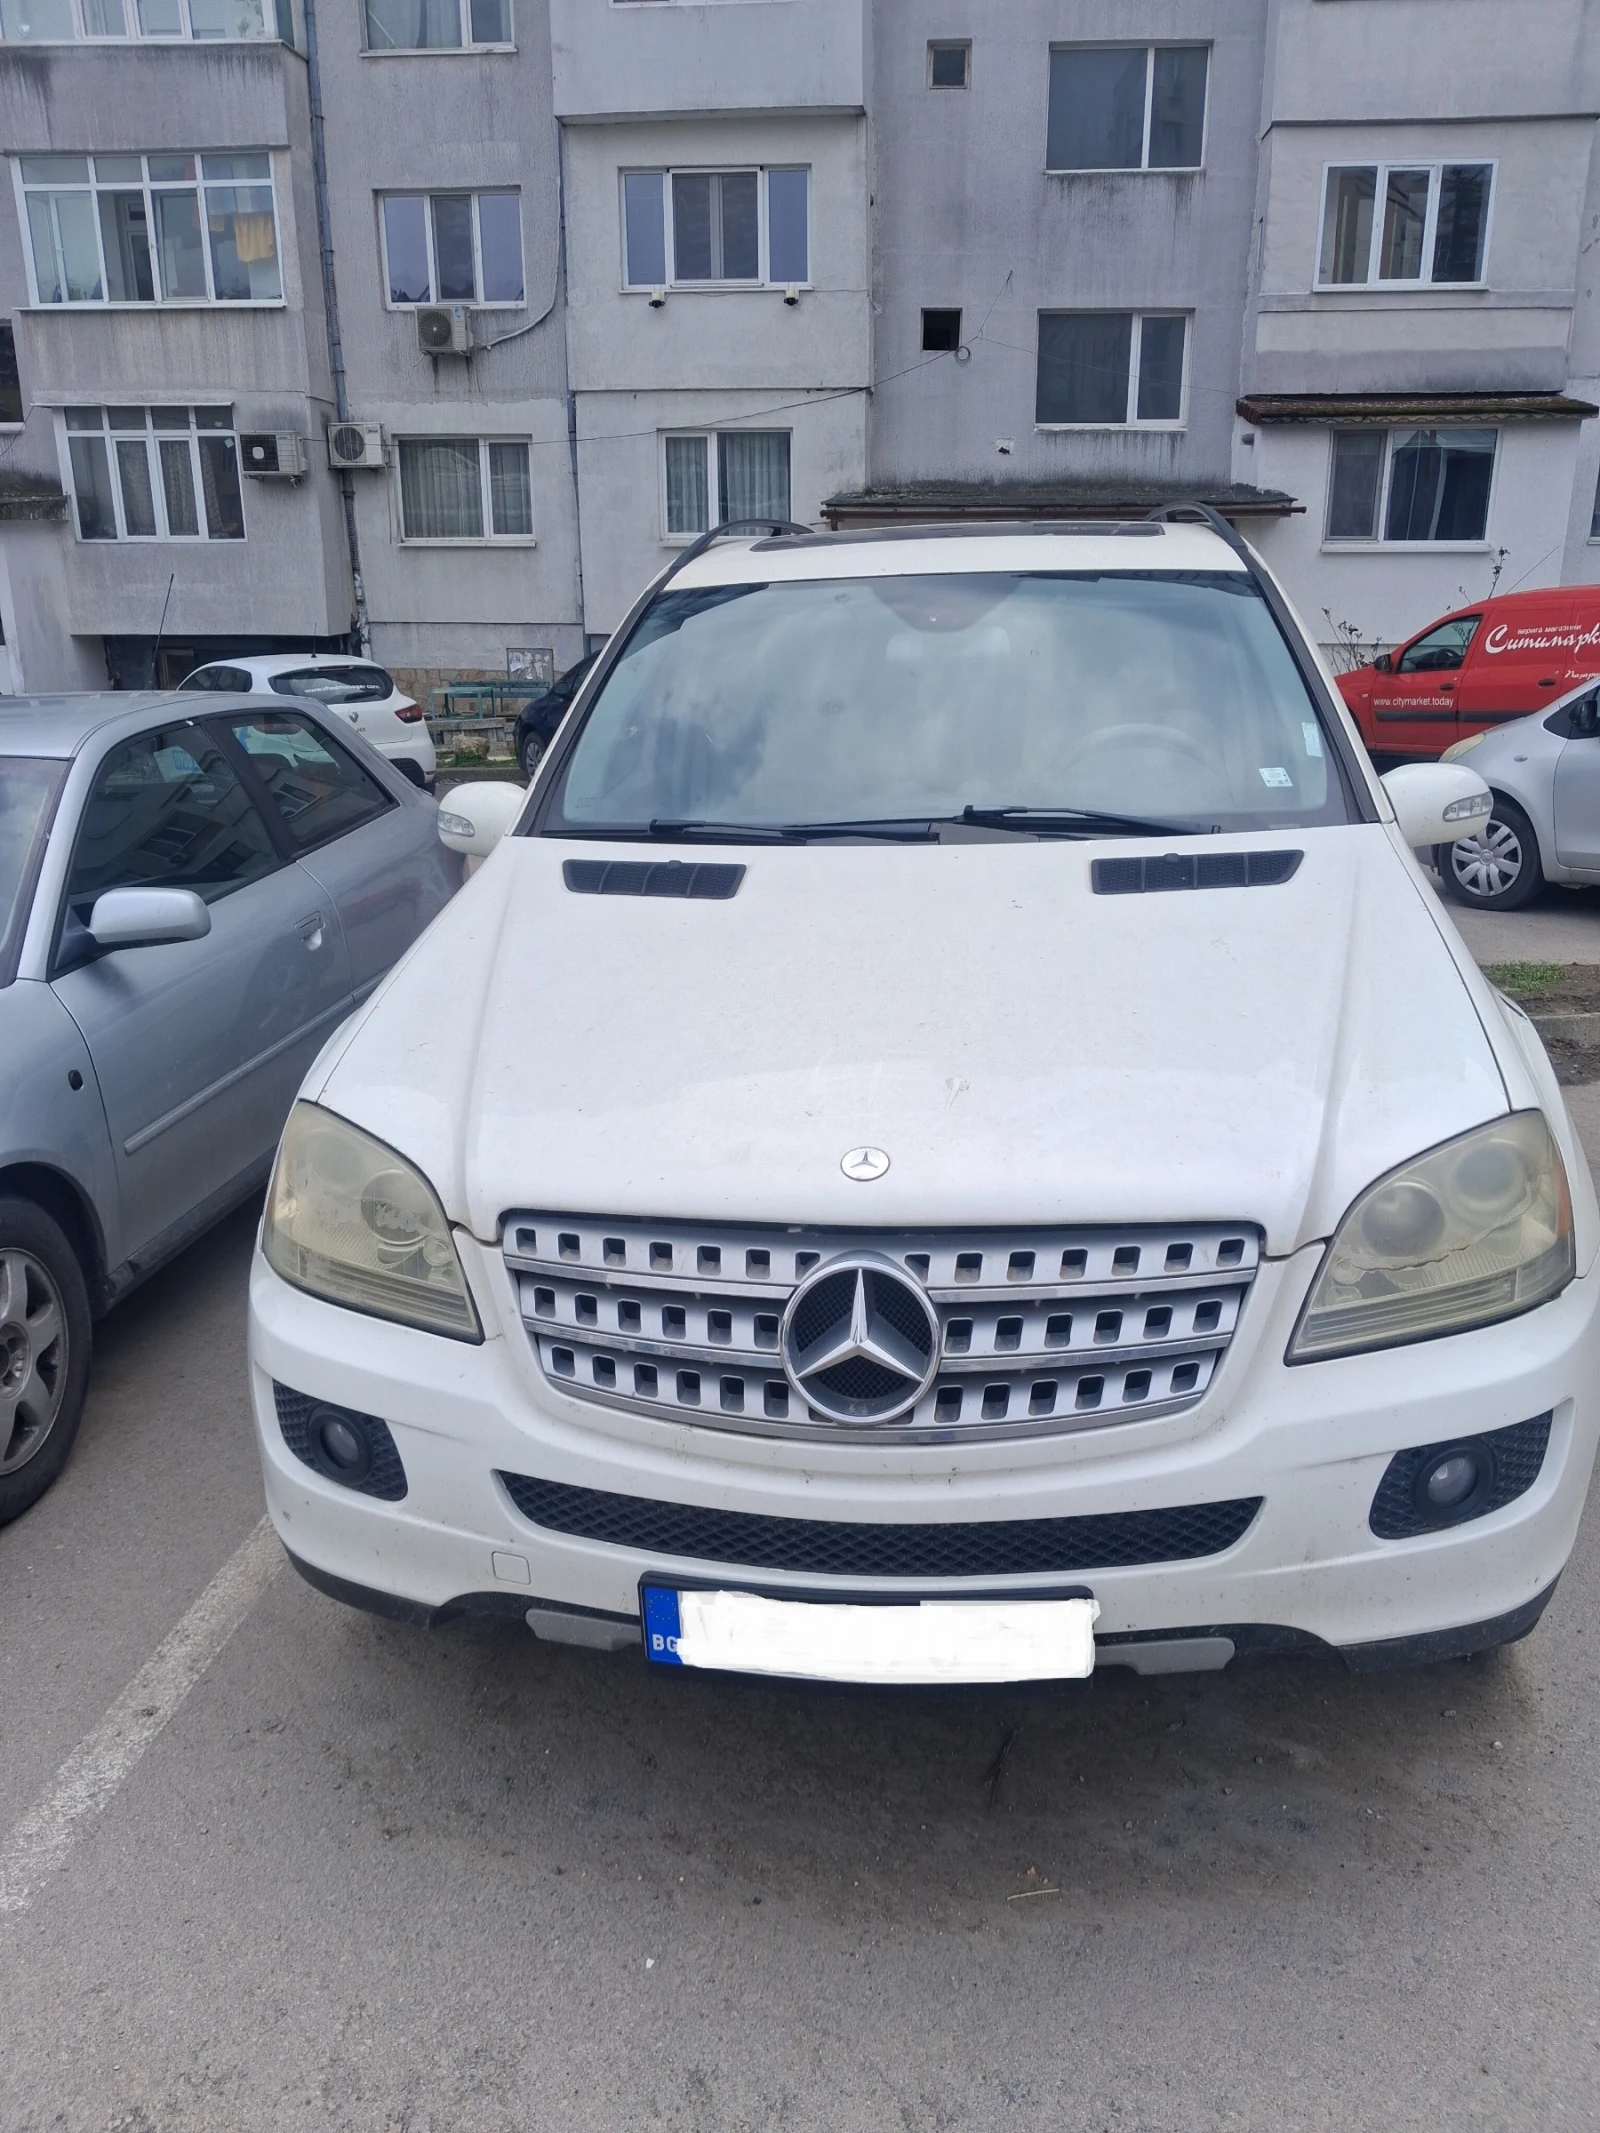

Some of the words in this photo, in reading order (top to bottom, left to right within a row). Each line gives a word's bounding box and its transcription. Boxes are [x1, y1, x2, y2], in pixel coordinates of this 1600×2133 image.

[1485, 624, 1600, 654] Ситимарк
[1373, 696, 1454, 708] www.citymarket.today
[652, 1633, 678, 1653] BG
